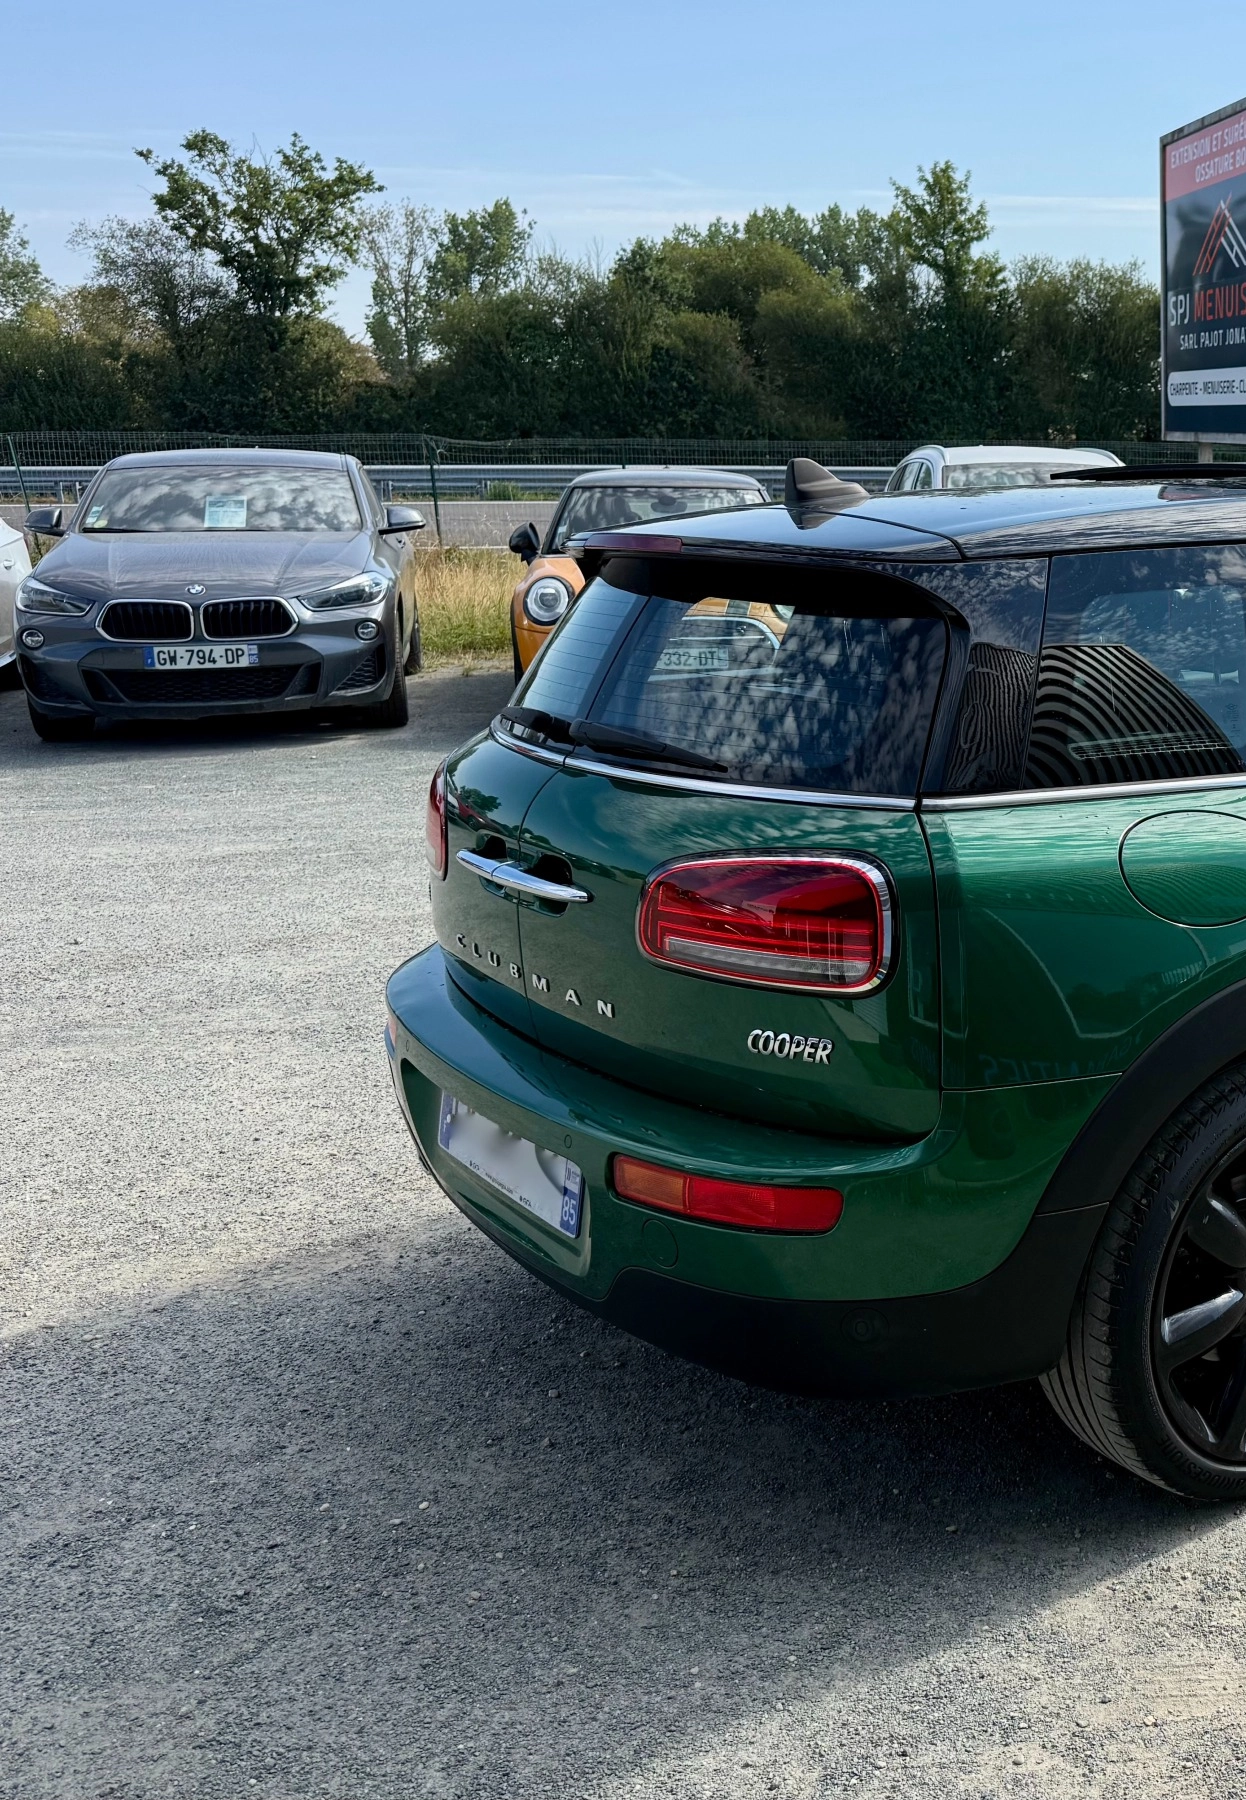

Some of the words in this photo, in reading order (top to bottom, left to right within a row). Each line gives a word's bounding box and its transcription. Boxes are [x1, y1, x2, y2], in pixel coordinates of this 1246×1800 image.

[1171, 141, 1211, 169] EXTENSION
[1212, 130, 1222, 152] ET
[1195, 151, 1233, 183] OSSATURE
[1170, 293, 1190, 327] SPJ
[1180, 332, 1198, 350] SARL
[1200, 330, 1223, 348] PAJOT
[1170, 382, 1198, 396] CHARPENTE
[1203, 380, 1235, 394] MENUISERIE
[156, 647, 245, 667] GW-794-DP
[249, 655, 258, 664] 85
[456, 933, 615, 1018] CLUBMAN
[747, 1029, 833, 1065] COOPER
[562, 1195, 576, 1225] 85
